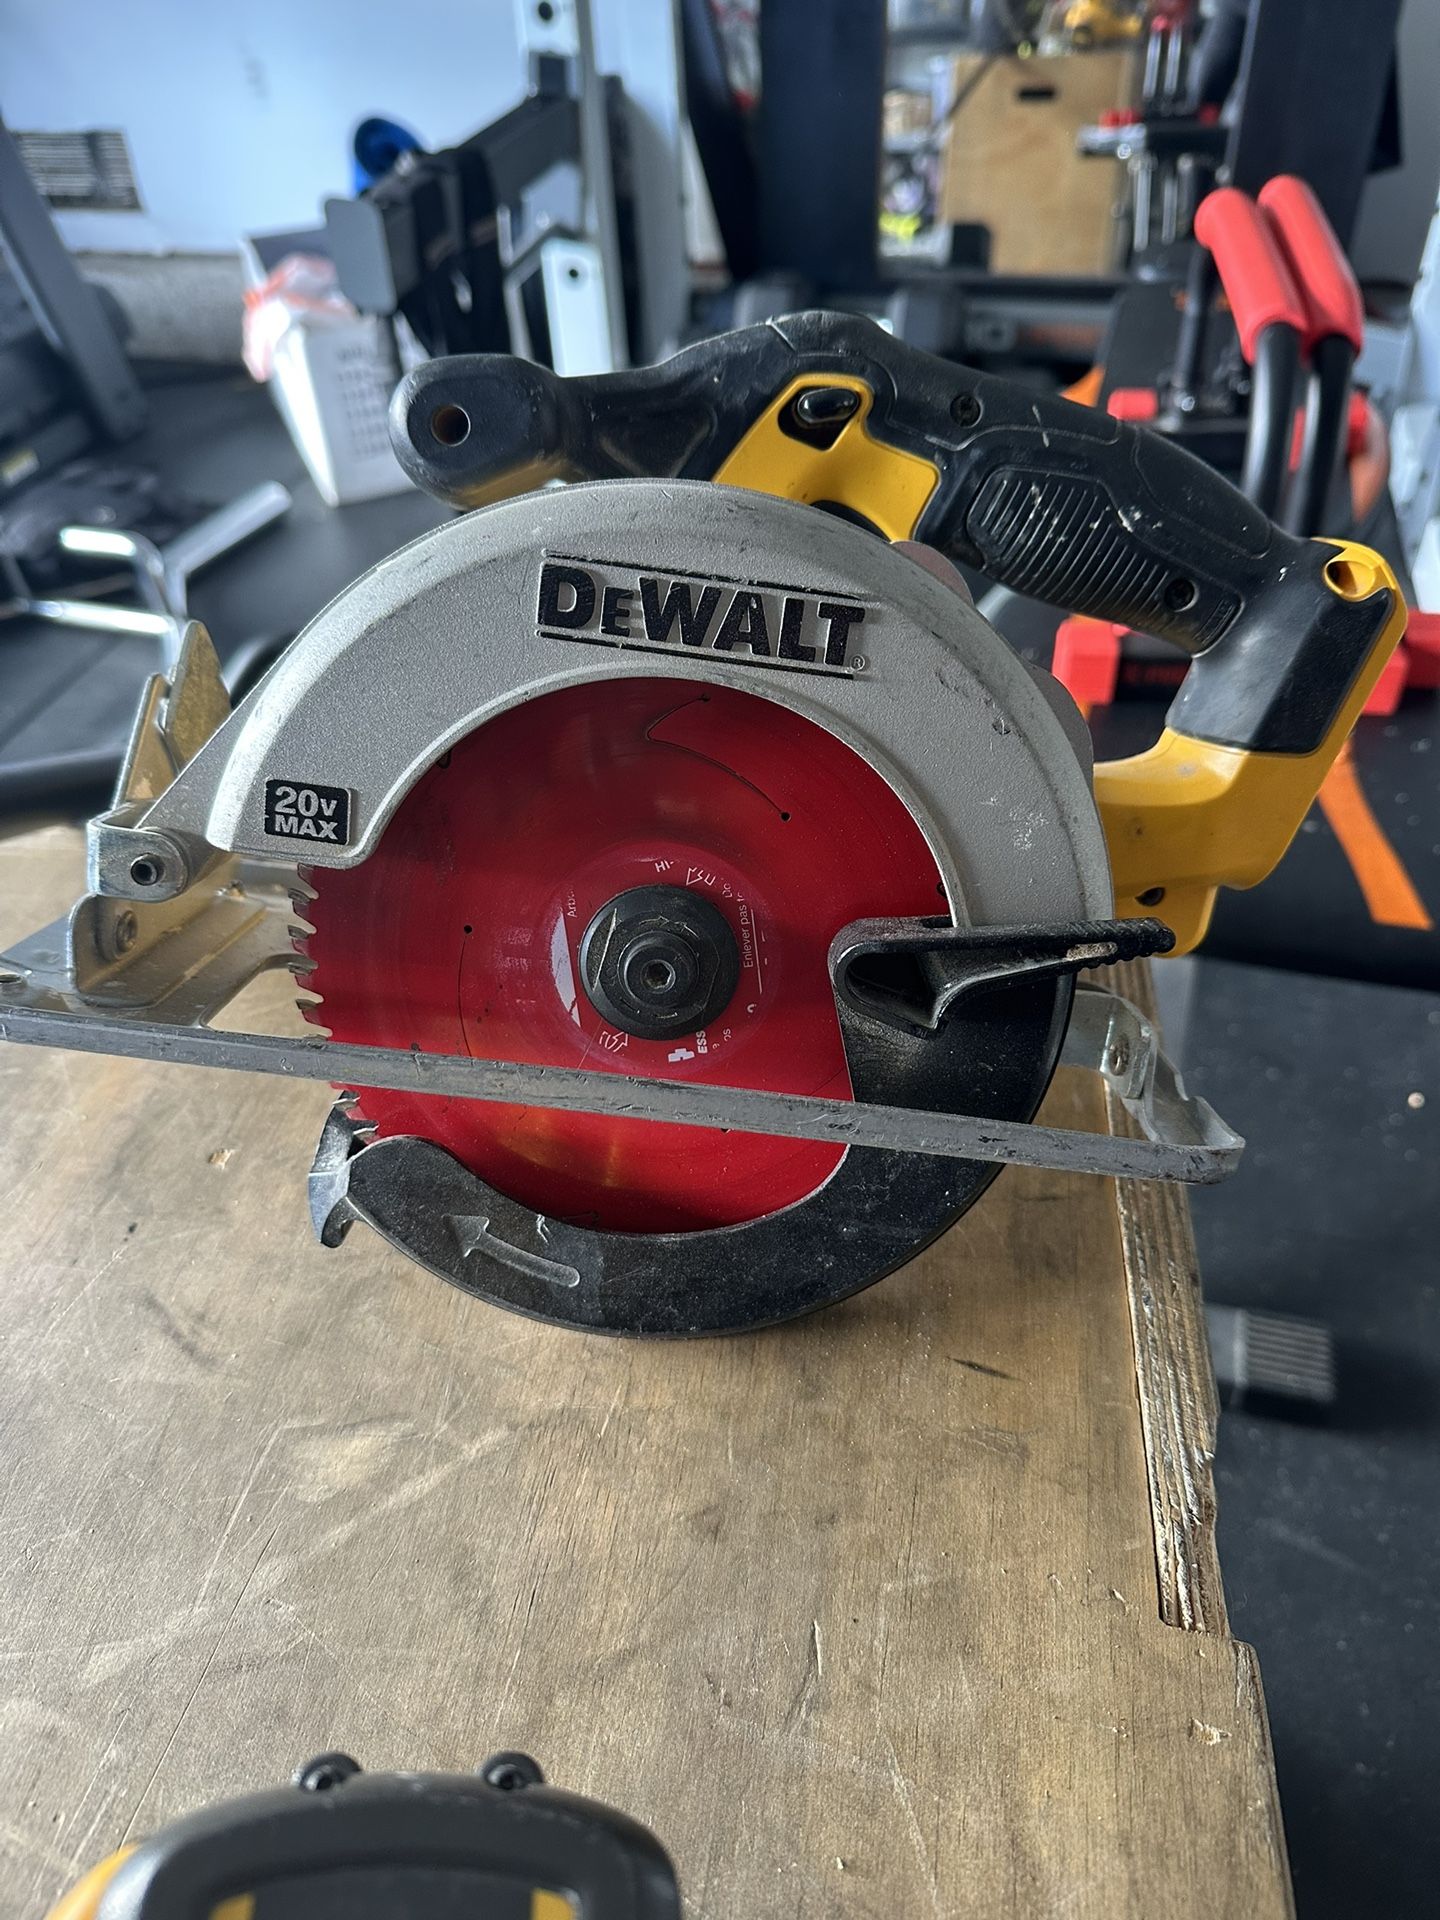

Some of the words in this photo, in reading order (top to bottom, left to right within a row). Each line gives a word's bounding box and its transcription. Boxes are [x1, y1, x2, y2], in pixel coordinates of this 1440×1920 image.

[537, 563, 866, 667] DEWALT
[275, 814, 338, 840] MAX
[738, 904, 751, 925] pas
[741, 928, 754, 968] Enlever
